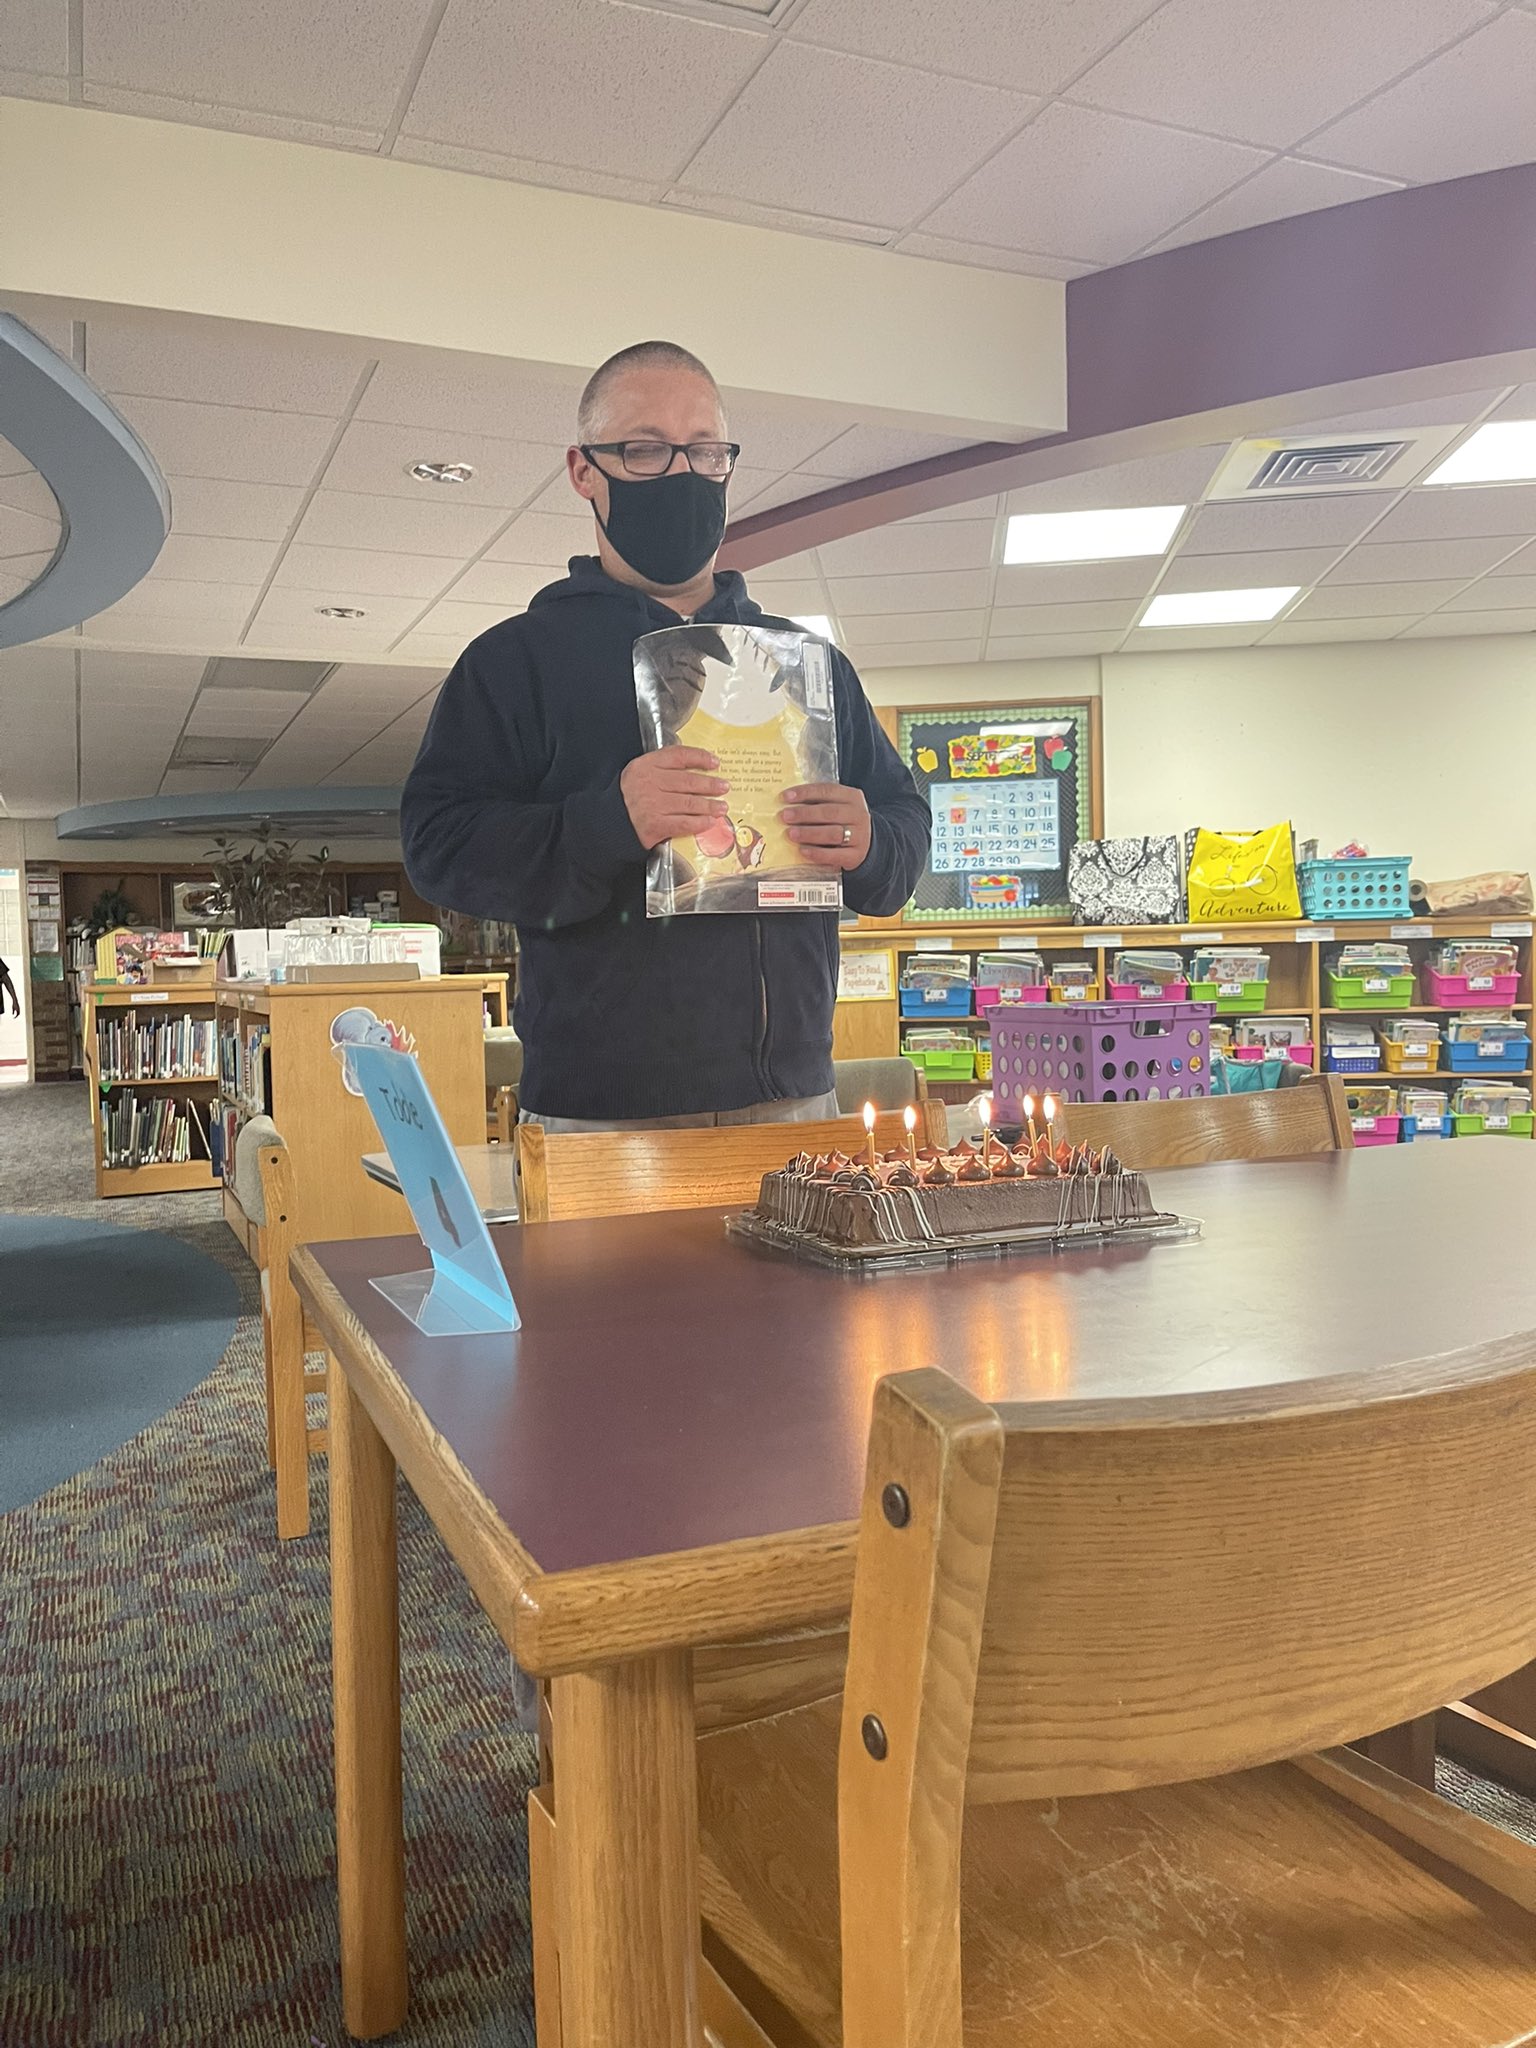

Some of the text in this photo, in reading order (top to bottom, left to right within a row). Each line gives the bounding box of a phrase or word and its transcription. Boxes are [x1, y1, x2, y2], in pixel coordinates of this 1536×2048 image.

[1009, 793, 1015, 803] 2
[1027, 791, 1034, 802] 3
[1044, 791, 1051, 800] 4
[938, 812, 945, 822] 5
[973, 810, 979, 820] 7
[1009, 808, 1016, 818] 9
[1025, 808, 1035, 817] 10
[1044, 807, 1051, 816] 11
[936, 823, 1053, 837] 12 13 14 15 16 17 18
[937, 838, 1055, 852] 19 20 21 22 23 24 25
[935, 856, 1020, 869] 26 27 28 29 30
[1199, 900, 1291, 918] Adventure
